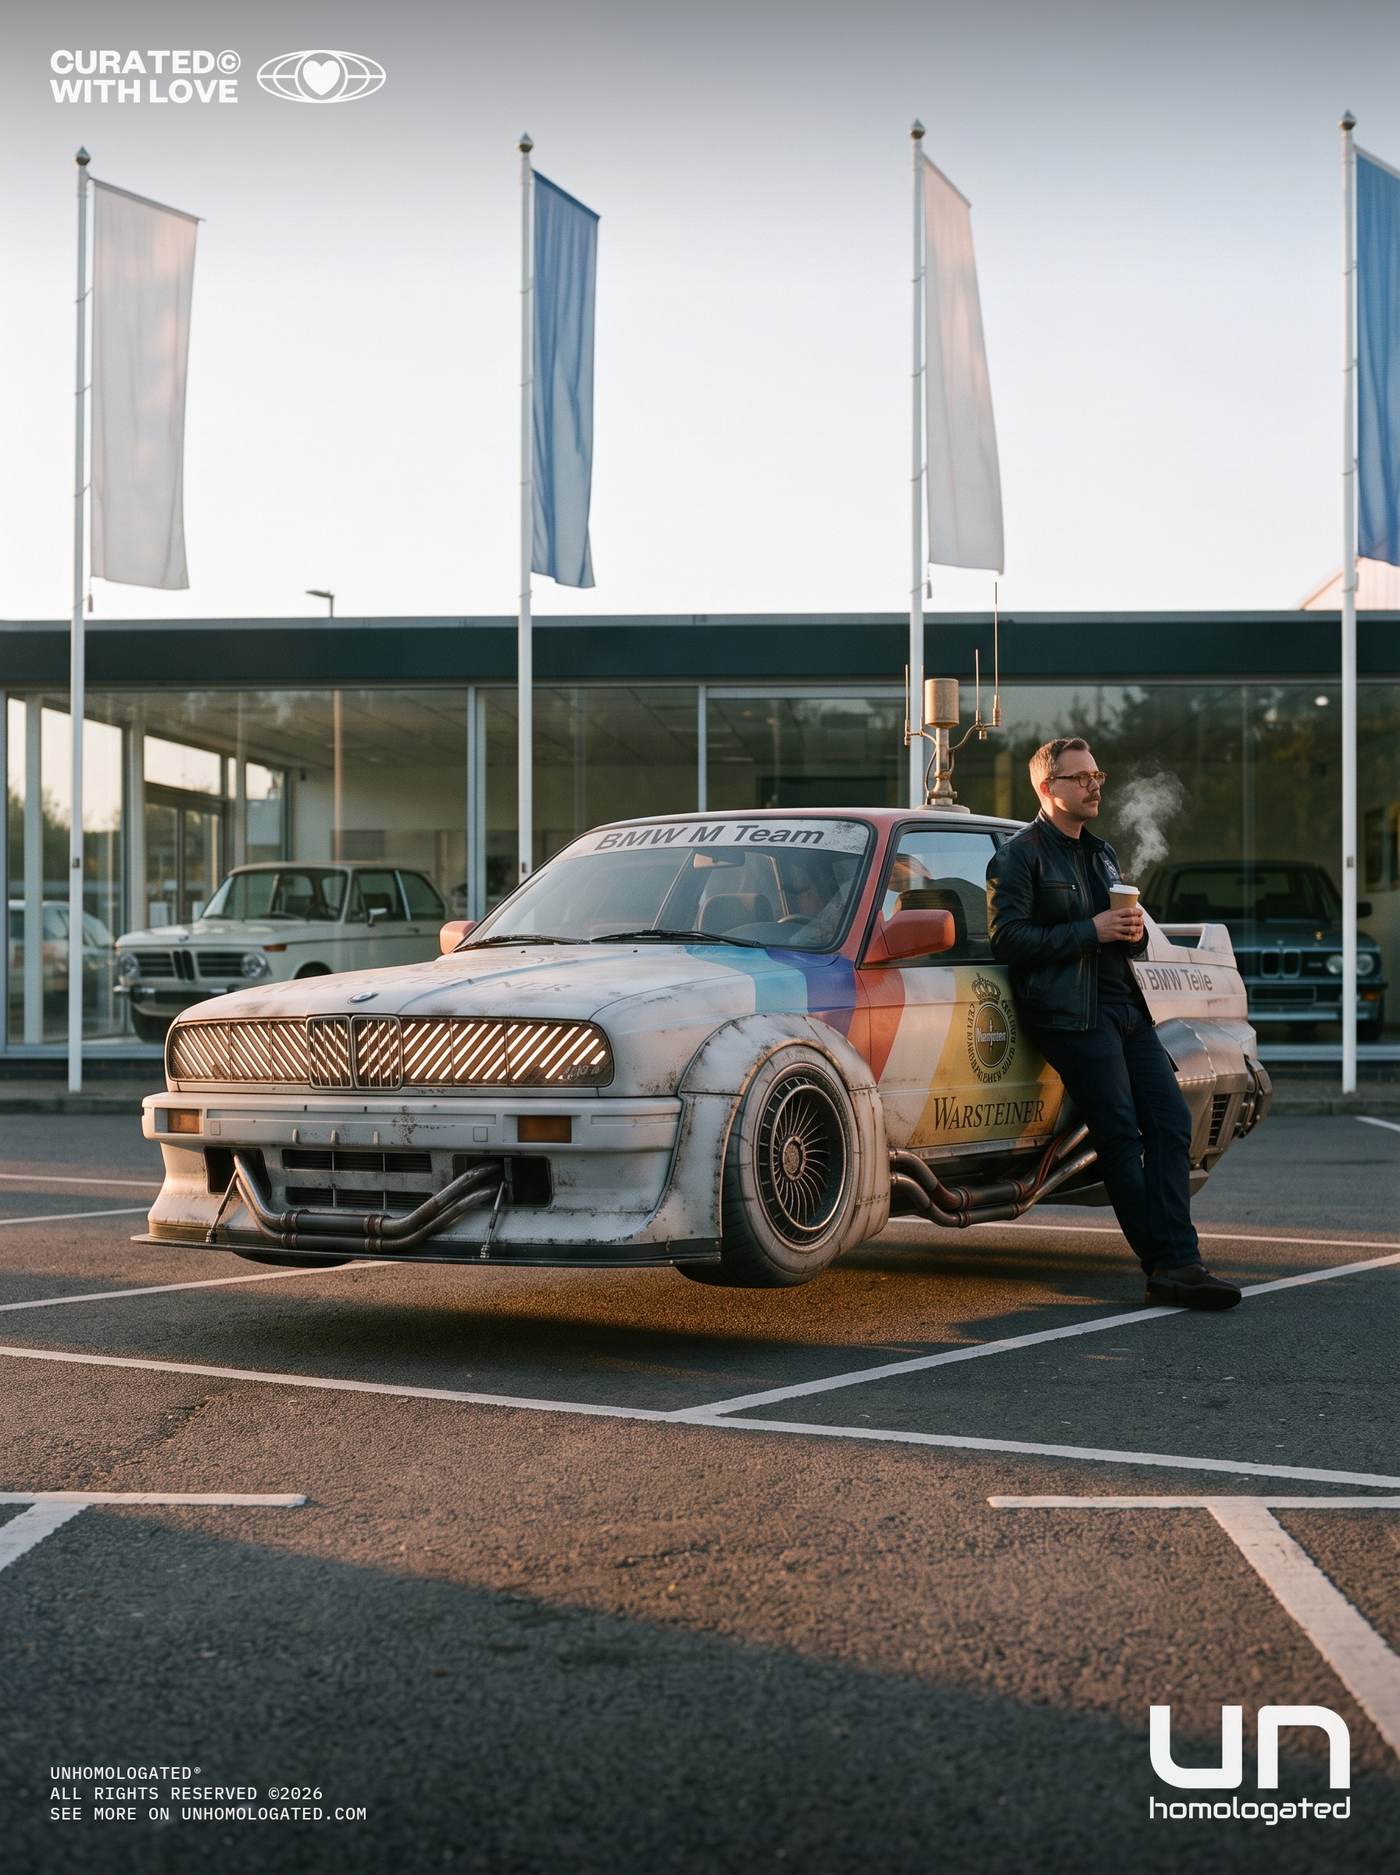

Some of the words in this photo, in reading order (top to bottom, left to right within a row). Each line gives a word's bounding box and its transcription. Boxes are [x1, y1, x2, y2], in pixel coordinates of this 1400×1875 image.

[595, 826, 687, 850] BMW
[688, 825, 726, 843] M
[733, 824, 824, 844] Team
[1145, 968, 1182, 991] BMW
[1181, 969, 1213, 991] Teile
[933, 1096, 1045, 1131] WARSTEINER
